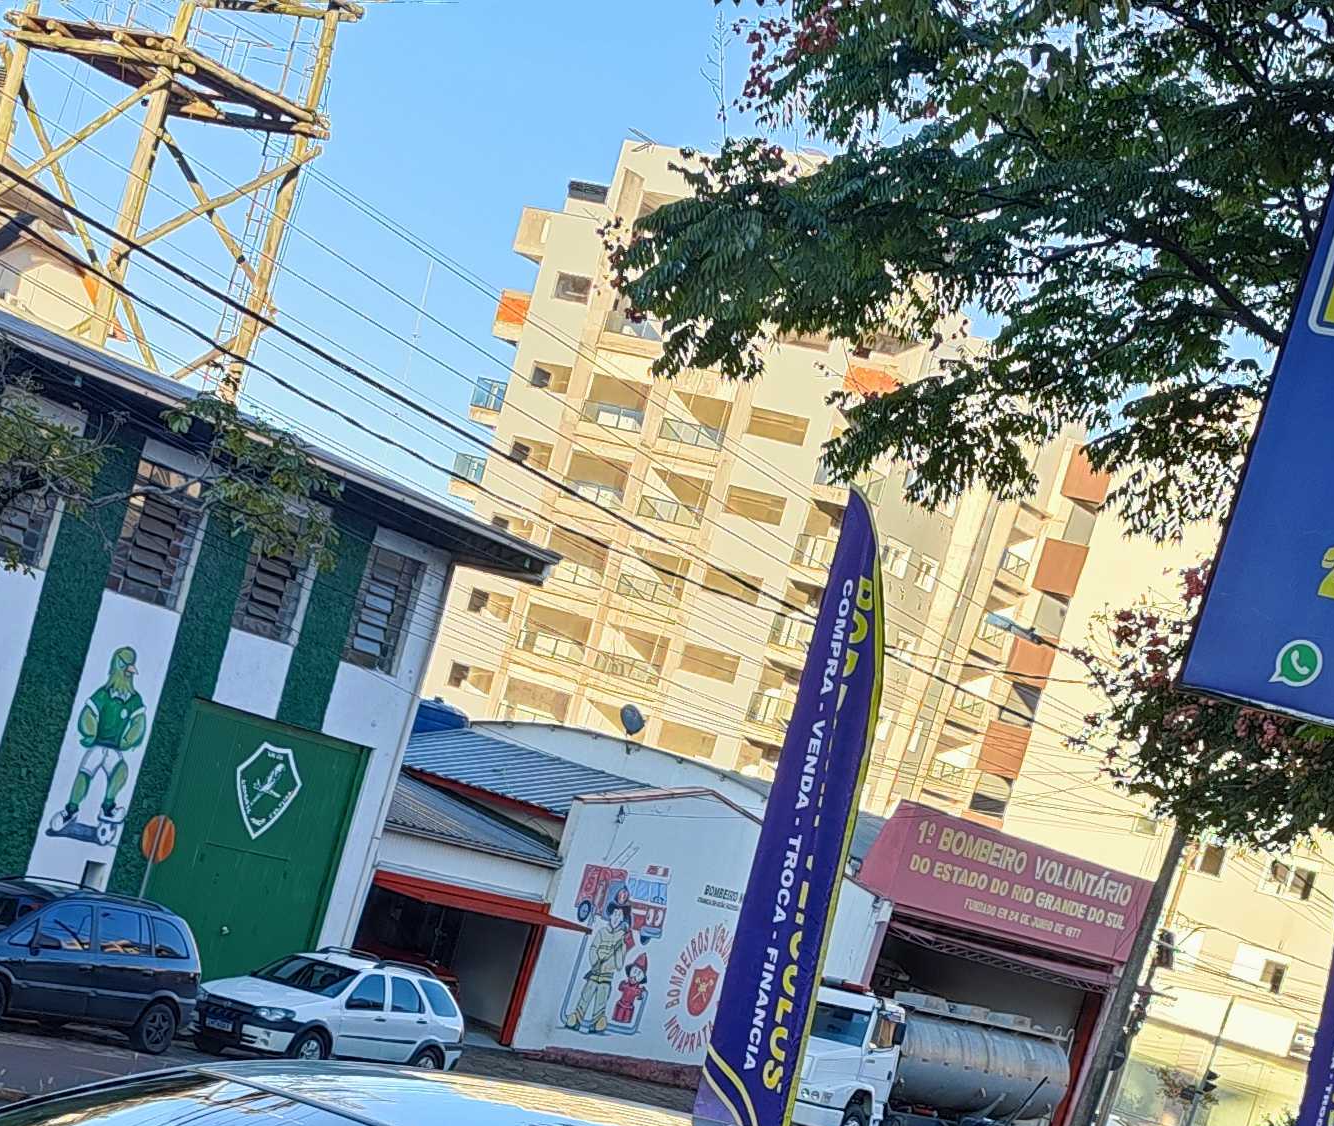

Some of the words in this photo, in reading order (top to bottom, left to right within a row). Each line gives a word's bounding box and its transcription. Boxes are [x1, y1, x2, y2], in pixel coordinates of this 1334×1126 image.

[820, 579, 854, 694] COMPRA
[795, 719, 826, 809] VENDA
[773, 834, 803, 923] TROCA
[910, 854, 930, 874] DO
[933, 863, 988, 890] ESTADO
[990, 878, 1009, 897] DO
[1011, 884, 1034, 903] RIO
[1036, 892, 1087, 919] GRANDE
[1088, 908, 1105, 924] DO
[1105, 912, 1125, 930] SUL
[938, 827, 1027, 874] BOMBEIRO
[1035, 856, 1132, 907] VOLUNTÁRIO
[666, 927, 710, 1009] BOMBEIROS
[744, 947, 778, 1070] FINANCIA
